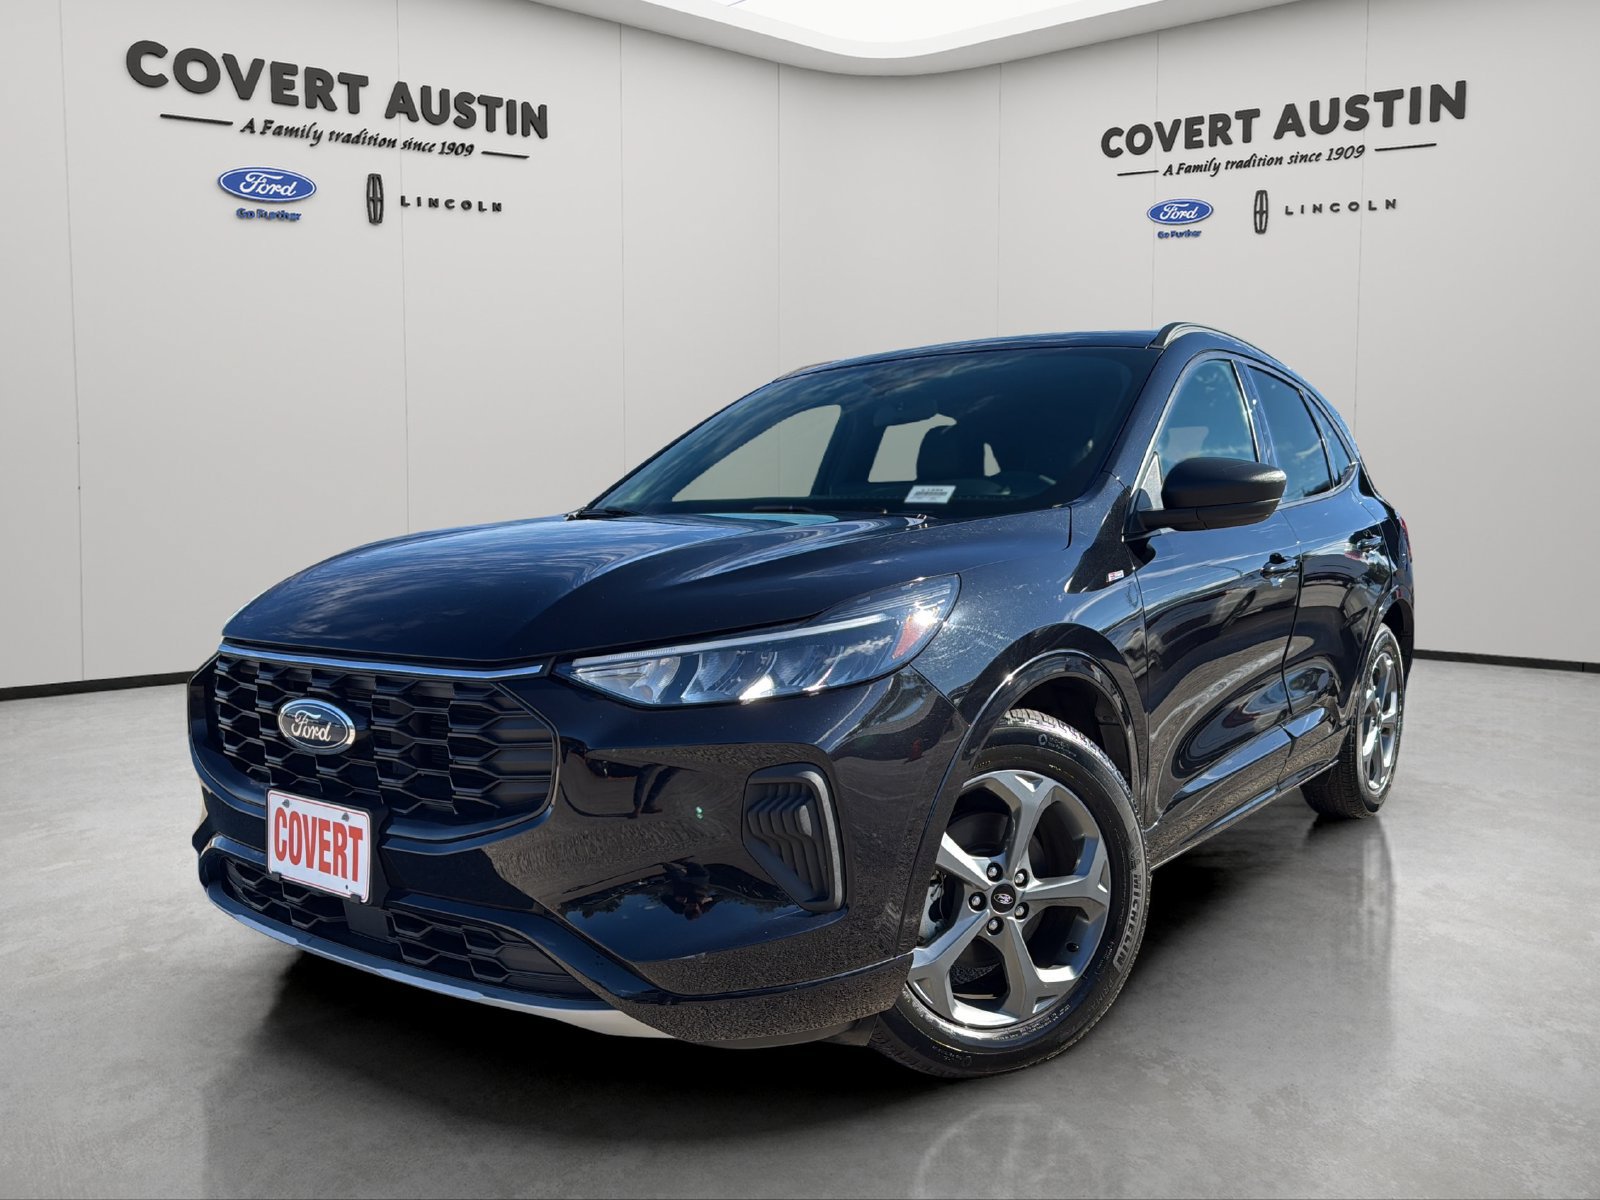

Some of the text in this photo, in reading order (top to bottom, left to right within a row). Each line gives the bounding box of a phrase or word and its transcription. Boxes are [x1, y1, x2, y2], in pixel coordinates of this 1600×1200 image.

[126, 40, 548, 139] COVERT AUSTIN
[1100, 80, 1466, 159] COVERT AUSTIN
[239, 117, 475, 157] A Family tradition since 1909
[1162, 144, 1366, 178] A Family tradition since 1909
[239, 172, 298, 196] Ford
[400, 195, 502, 213] LINCOLN
[1160, 203, 1199, 220] Ford
[1284, 198, 1397, 216] LINCOLN
[291, 709, 332, 742] Ford
[274, 806, 363, 883] COVERT
[1116, 873, 1142, 968] MICHELIN
